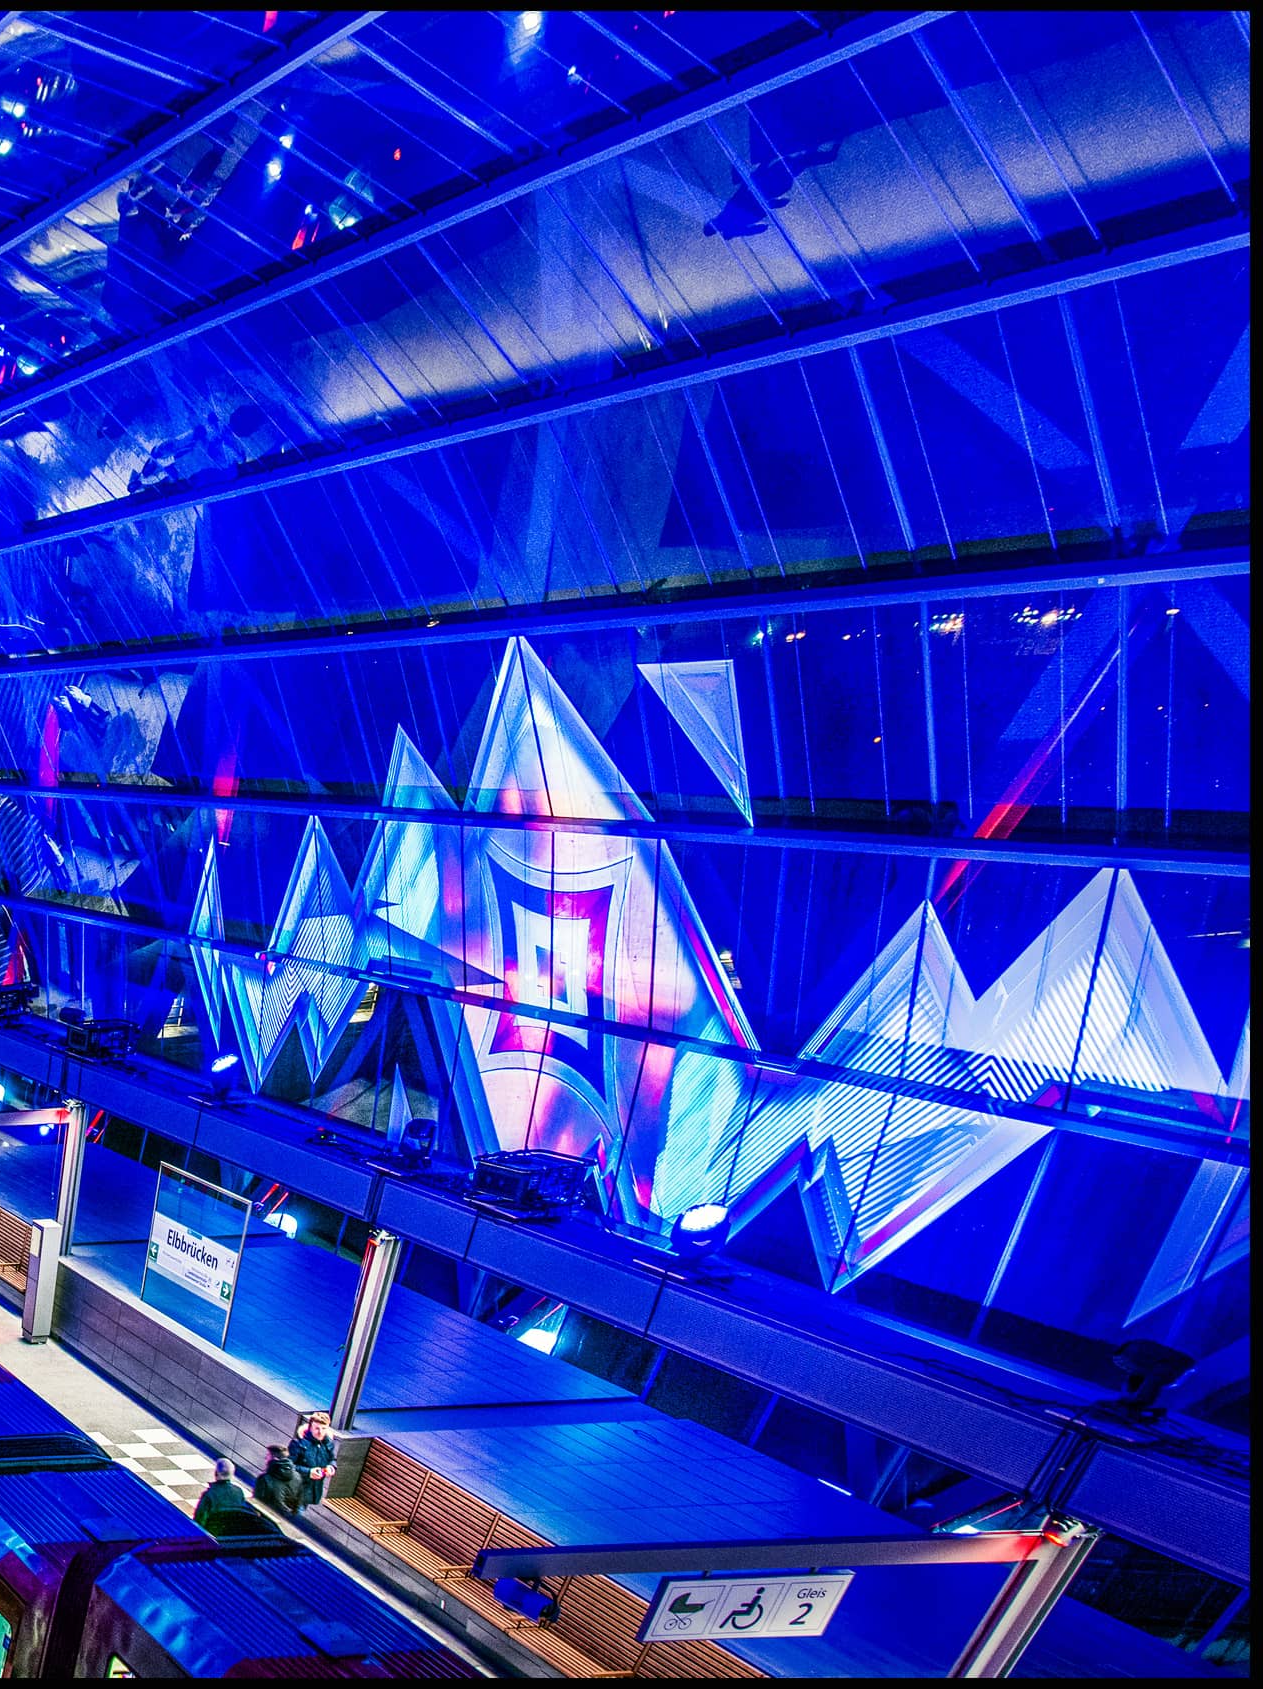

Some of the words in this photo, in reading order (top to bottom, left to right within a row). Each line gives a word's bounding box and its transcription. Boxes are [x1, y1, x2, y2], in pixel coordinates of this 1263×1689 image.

[166, 1228, 218, 1270] Elbbrücken
[797, 1587, 828, 1600] Gleis
[788, 1602, 814, 1626] 2
